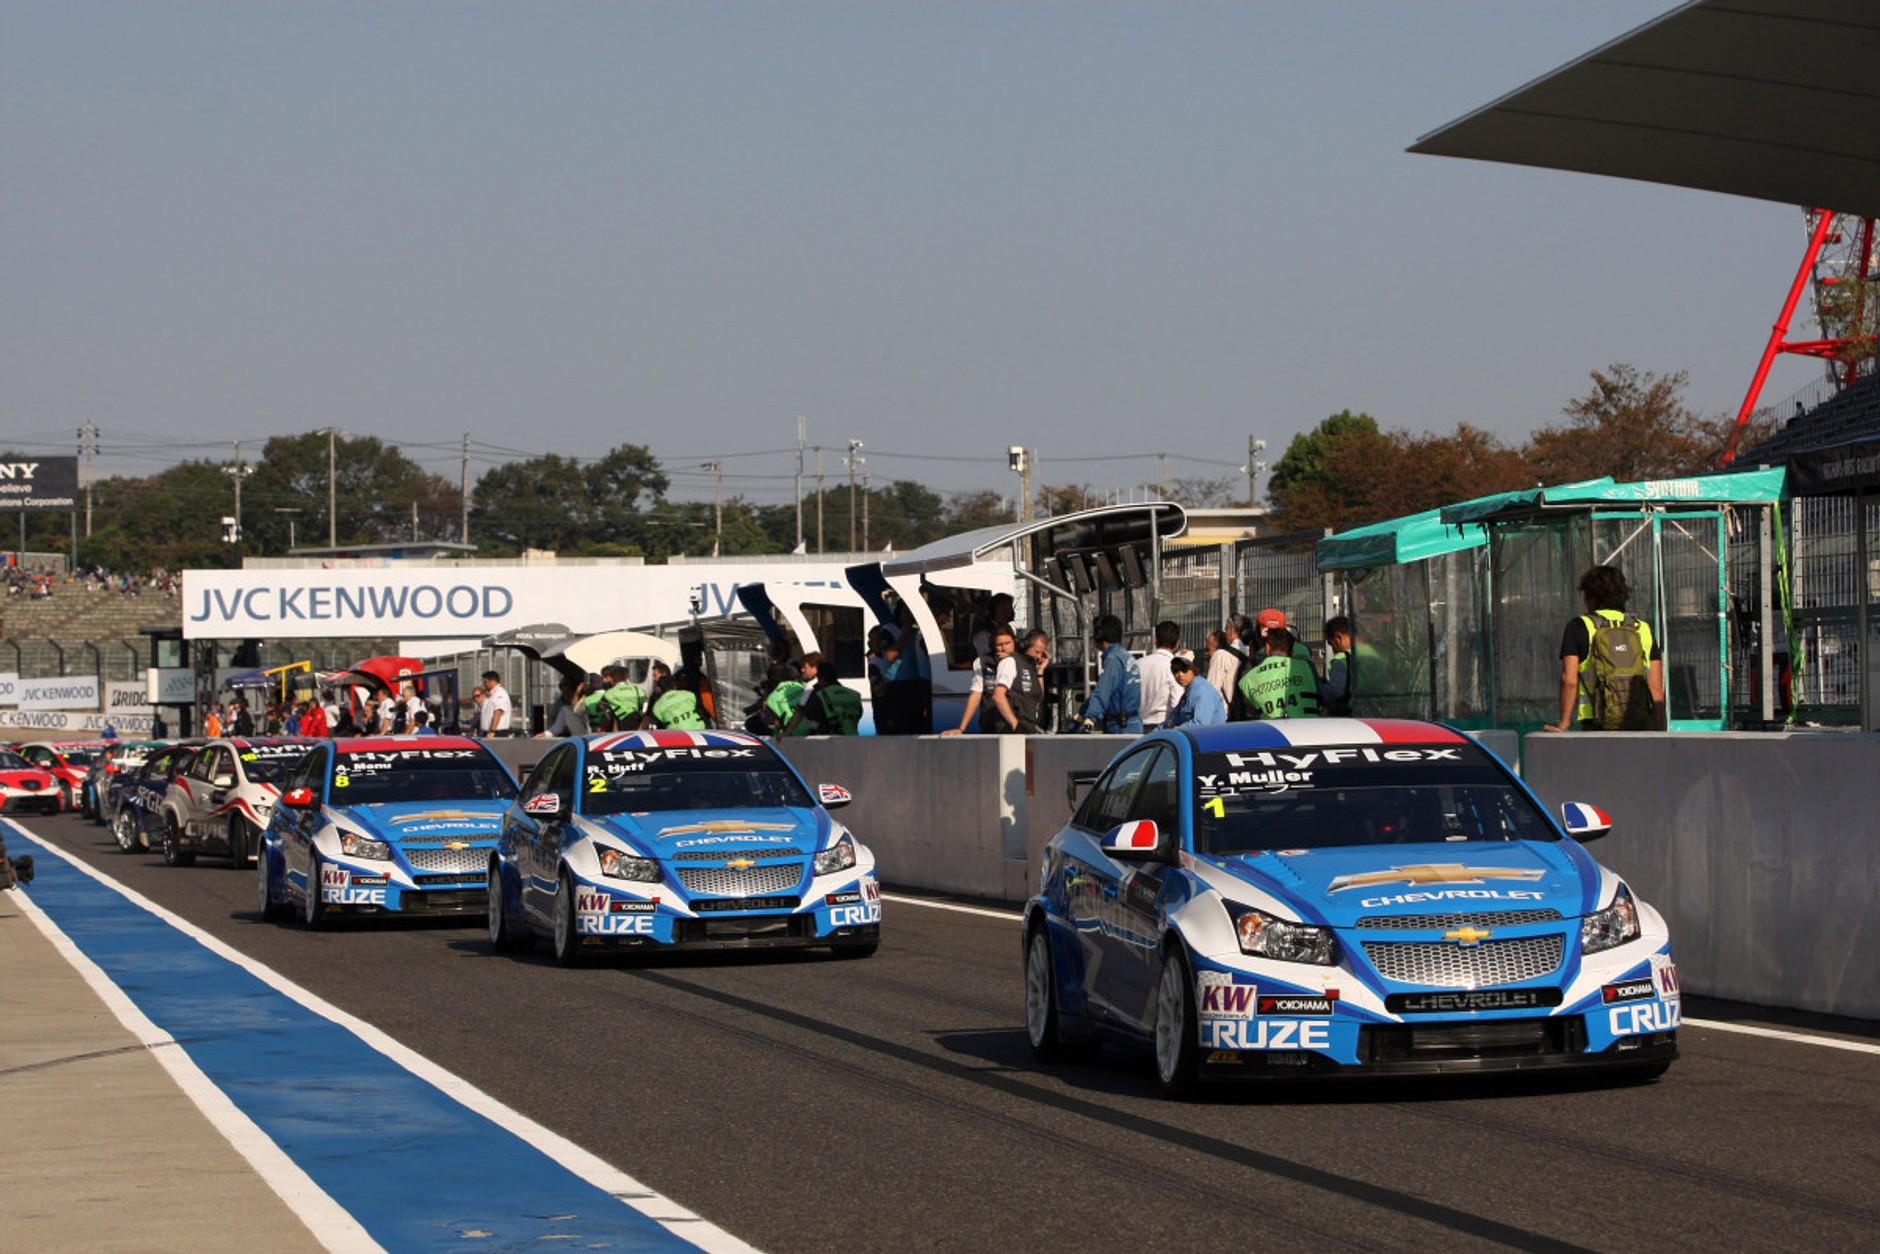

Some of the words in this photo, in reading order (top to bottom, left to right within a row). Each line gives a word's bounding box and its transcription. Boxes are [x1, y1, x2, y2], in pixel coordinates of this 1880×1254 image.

[350, 750, 476, 762] HyFlex
[603, 749, 755, 762] HyFlex
[1226, 748, 1462, 769] HyFlex
[608, 762, 645, 773] Huff
[335, 775, 350, 788] 8
[589, 778, 608, 793] 2
[1197, 774, 1225, 787] Y.
[1228, 770, 1314, 785] Muller
[1204, 797, 1225, 818] 1
[676, 836, 794, 847] CHEVROLET
[323, 870, 348, 885] KW
[321, 889, 386, 904] CRUZE
[578, 895, 609, 911] KW
[1361, 891, 1547, 908] CHEVROLET
[575, 915, 655, 934] CRUZE
[1202, 985, 1255, 1012] KW
[1276, 1000, 1331, 1010] YOKOHAMA
[1405, 992, 1537, 1010] CHEVROLET
[1200, 1020, 1330, 1049] CRUZE
